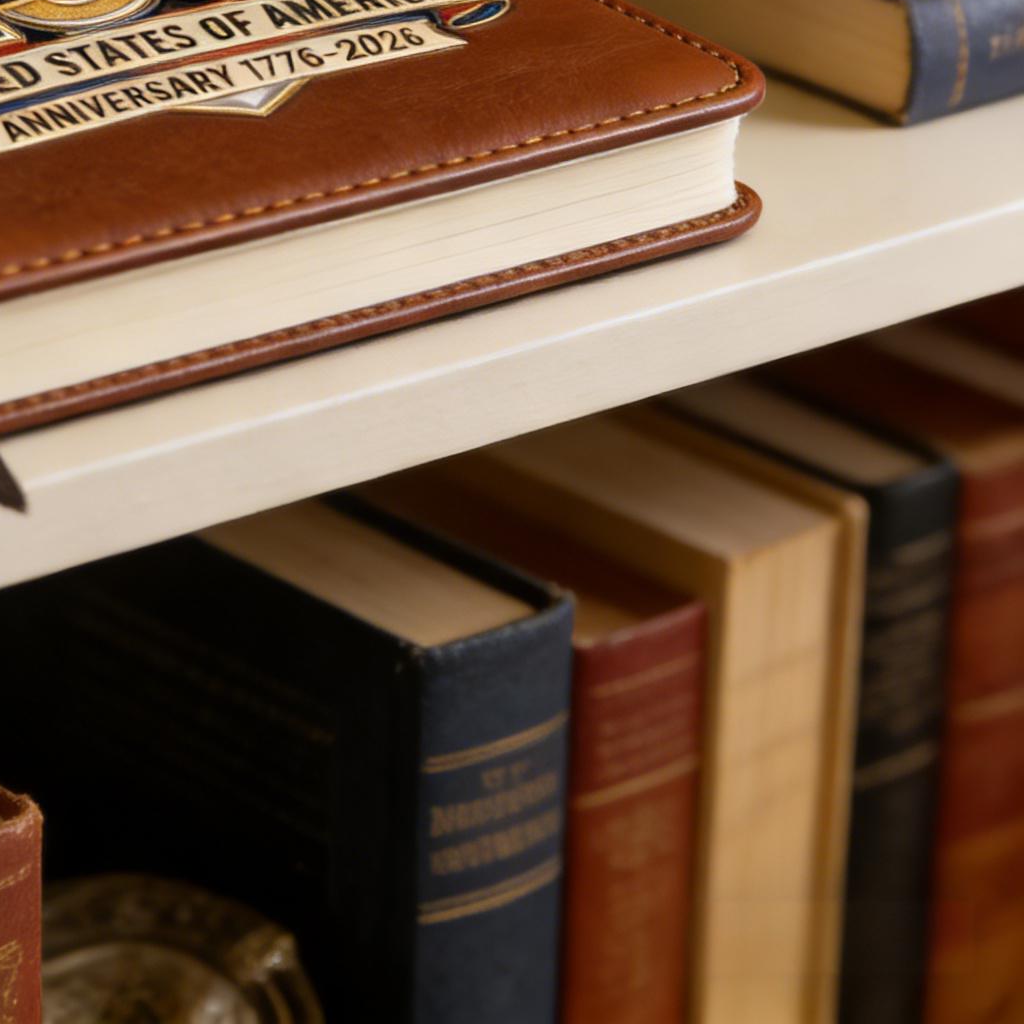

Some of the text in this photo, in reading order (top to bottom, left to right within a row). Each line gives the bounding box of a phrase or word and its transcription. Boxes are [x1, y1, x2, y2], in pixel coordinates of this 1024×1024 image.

[2, 28, 426, 143] ANNIVERSARY 1776-2026
[44, 24, 197, 77] STATES
[198, 9, 253, 42] OF
